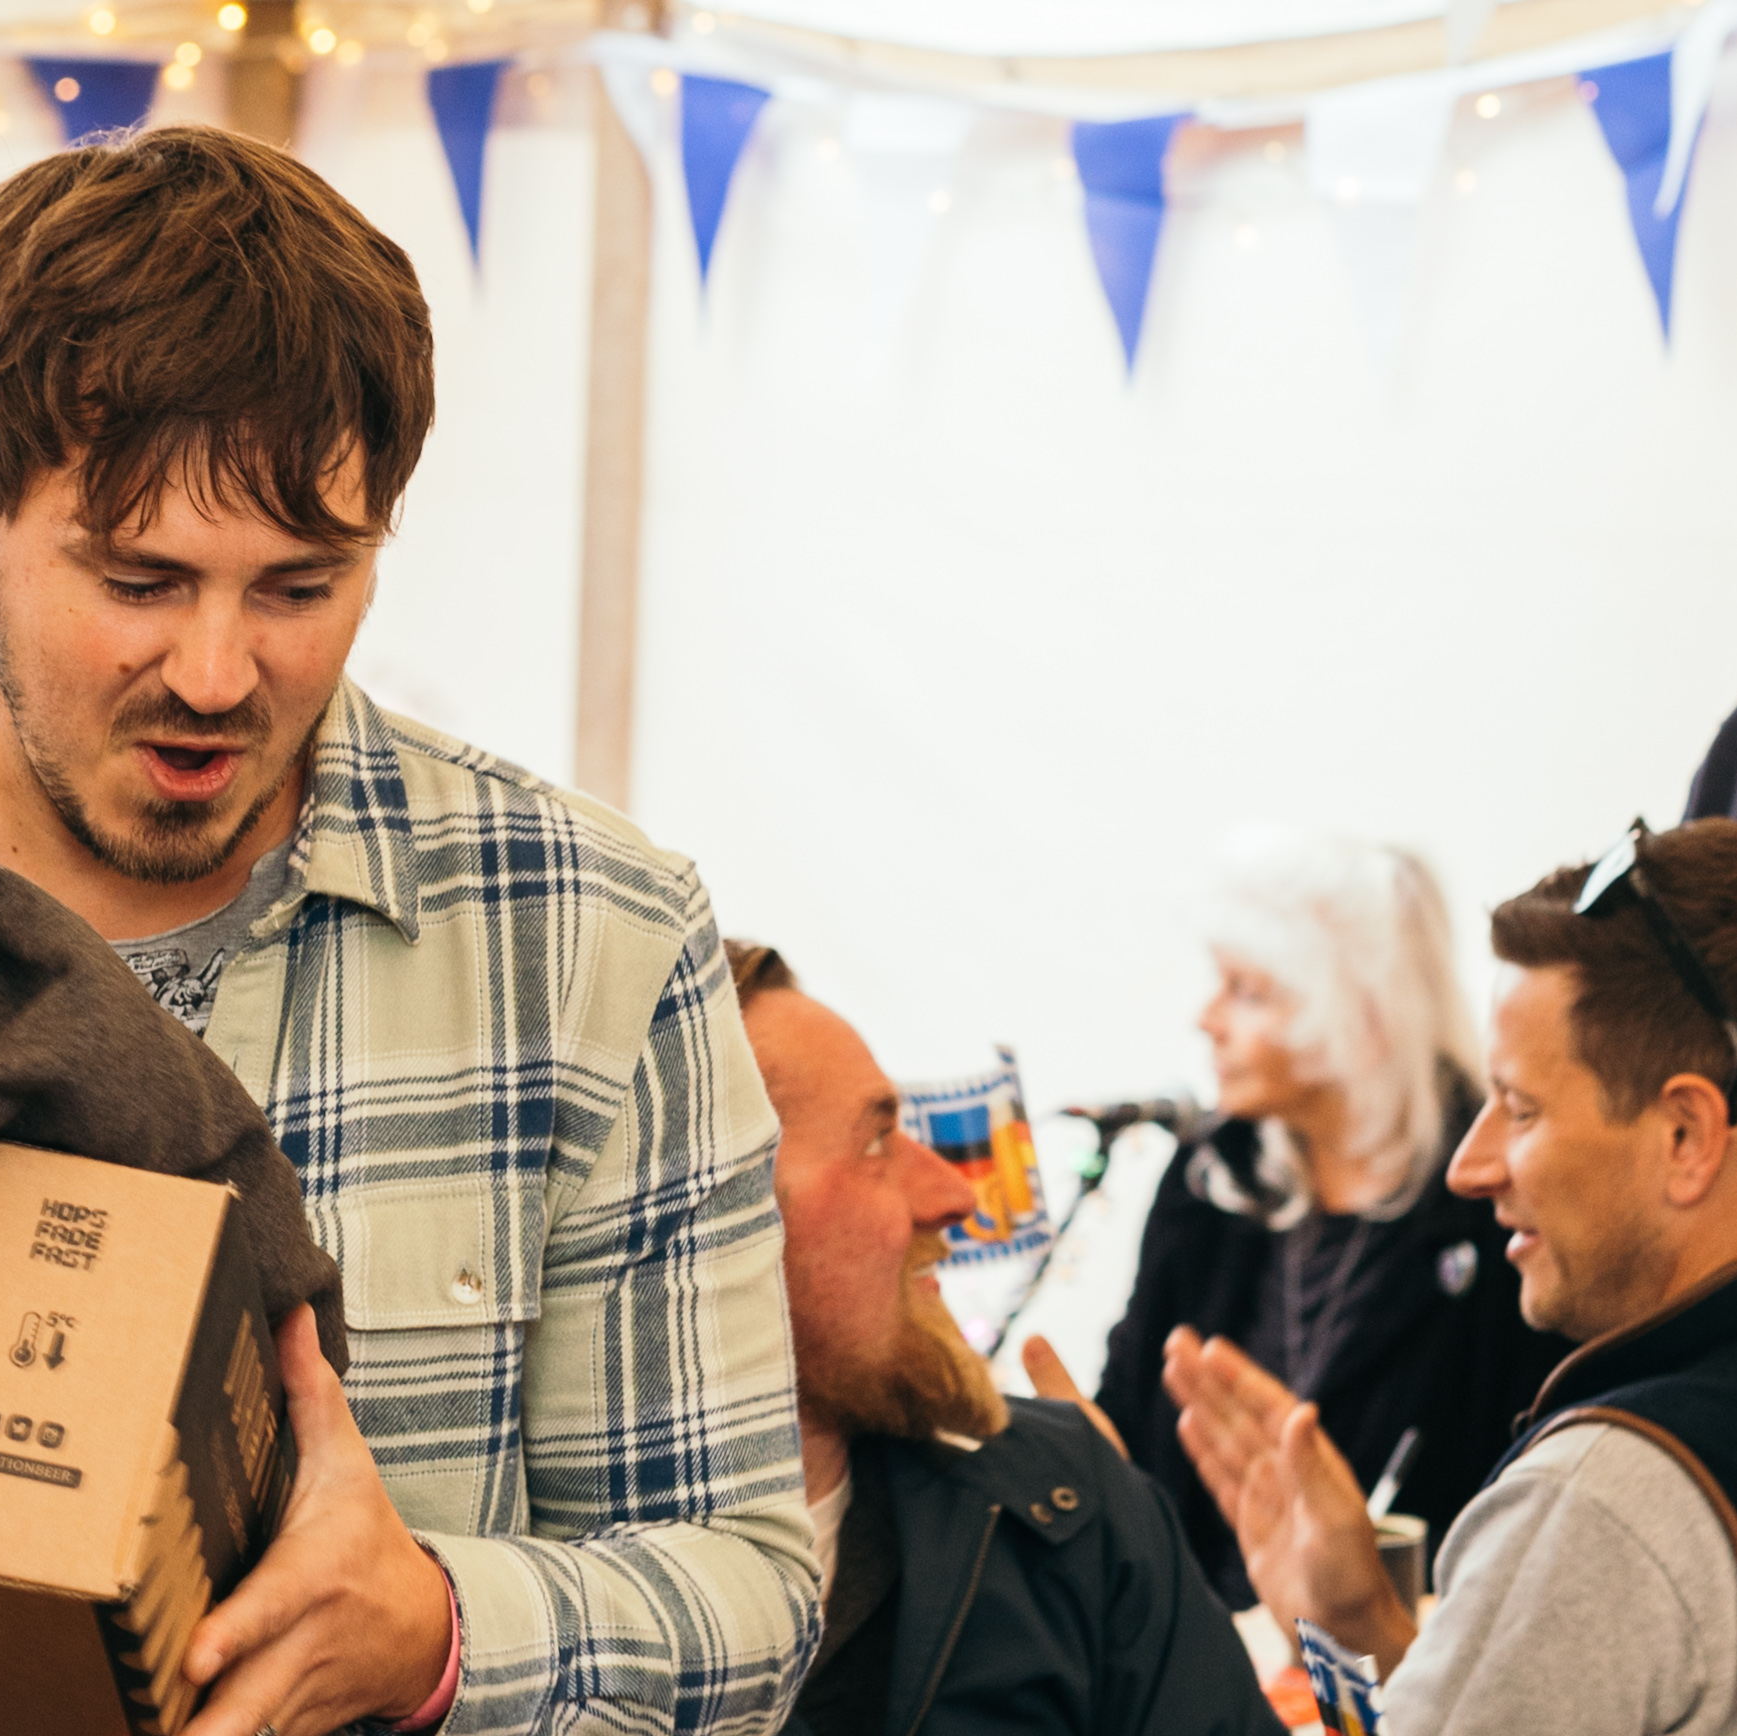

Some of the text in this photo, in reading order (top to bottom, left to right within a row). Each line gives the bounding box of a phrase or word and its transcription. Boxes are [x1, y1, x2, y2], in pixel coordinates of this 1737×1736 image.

[40, 1198, 107, 1229] HOPS
[35, 1220, 102, 1250] FADE
[29, 1242, 97, 1271] FAST
